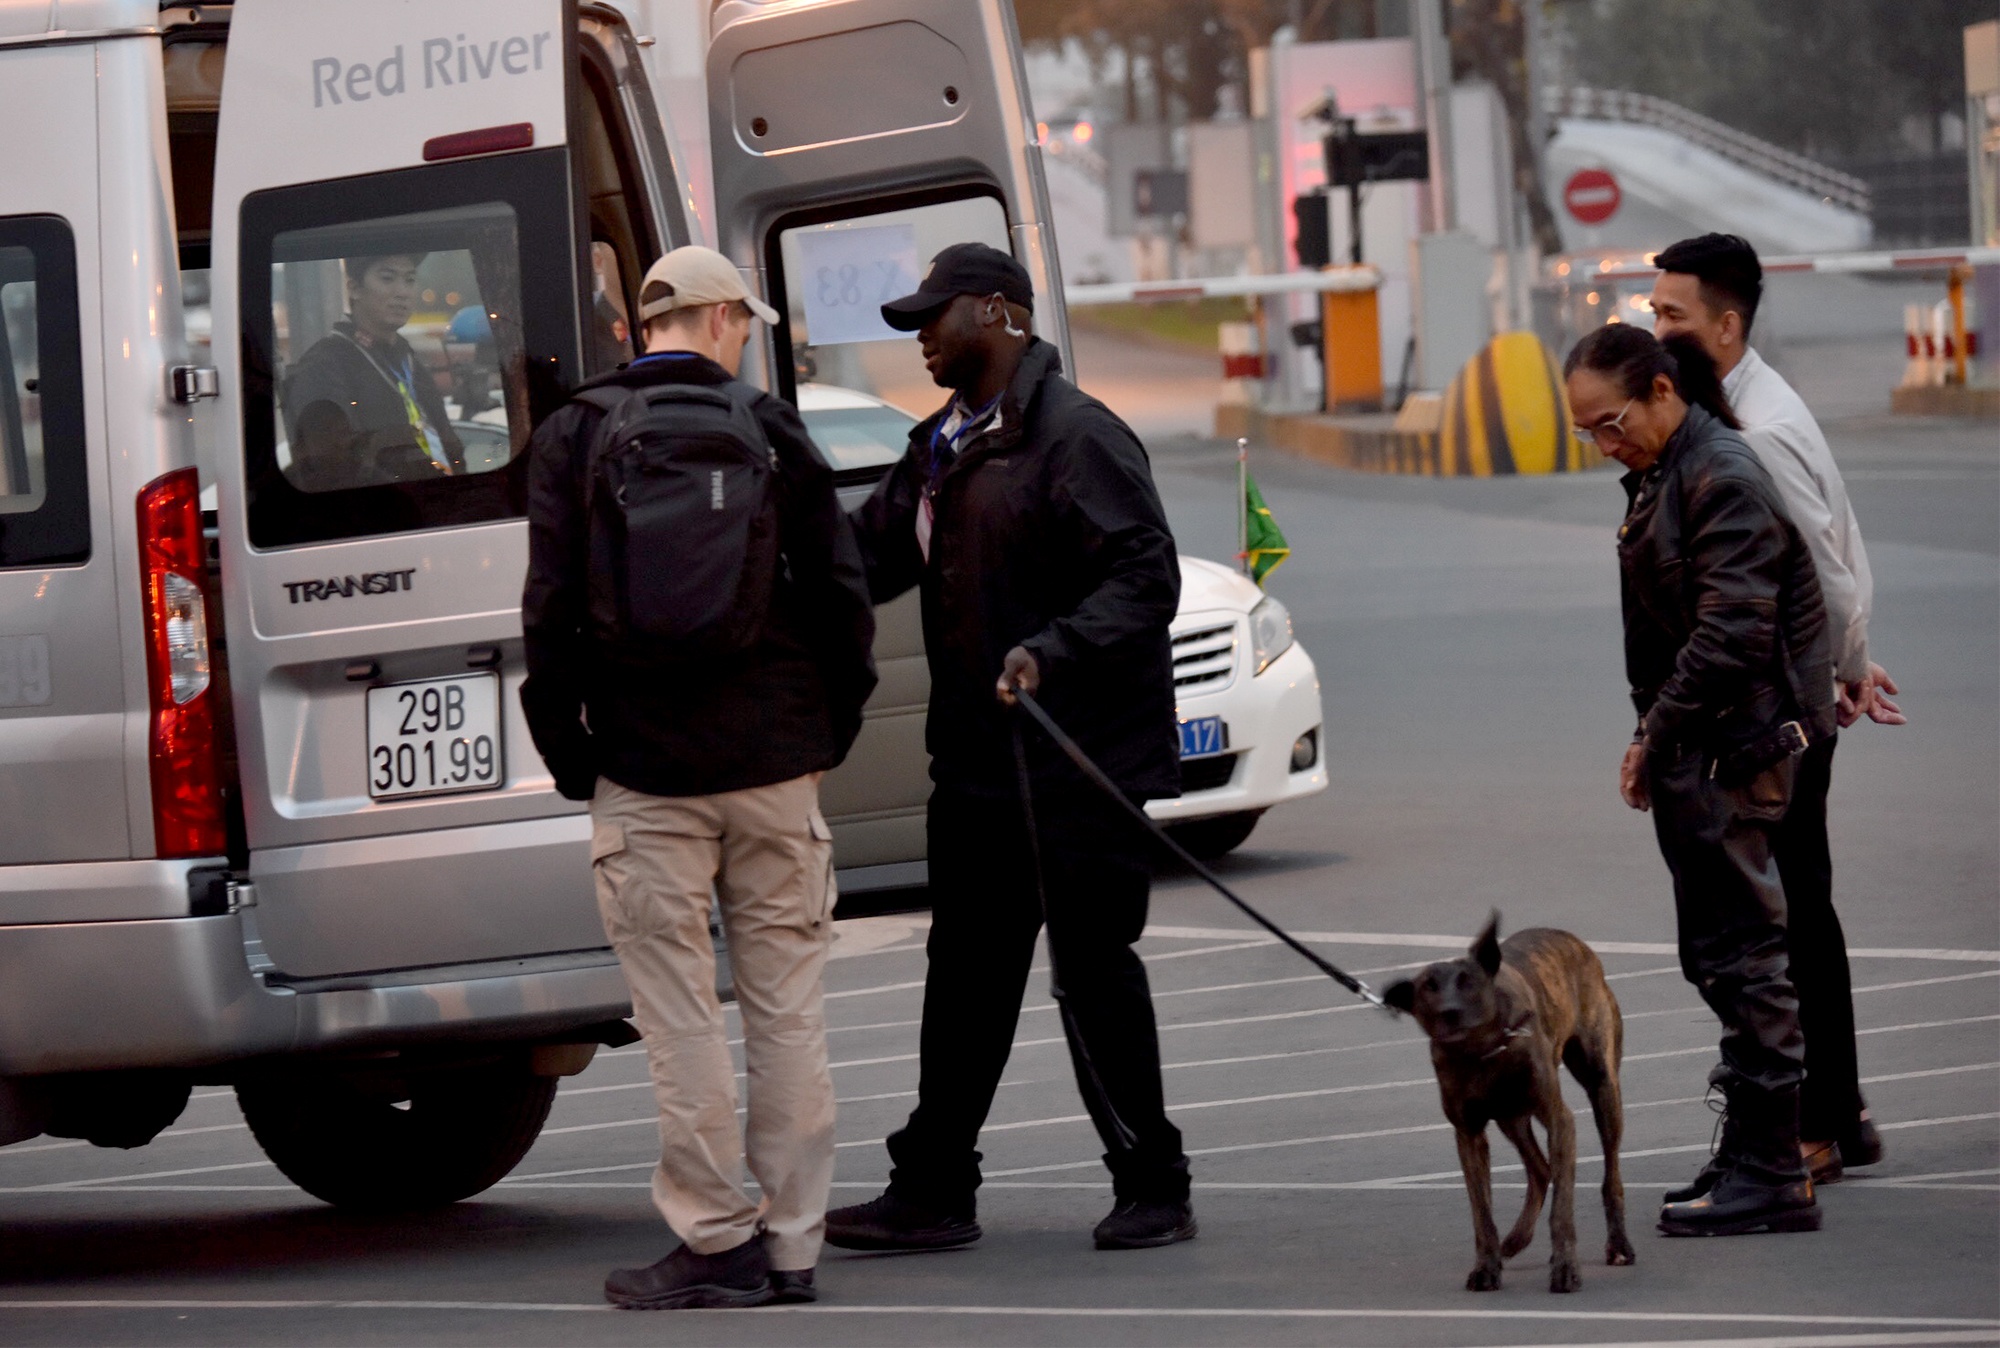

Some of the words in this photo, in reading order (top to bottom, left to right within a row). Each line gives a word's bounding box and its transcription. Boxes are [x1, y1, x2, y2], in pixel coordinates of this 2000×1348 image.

[312, 45, 406, 109] Red
[422, 30, 551, 90] River
[282, 567, 417, 605] TRANSIT
[398, 684, 465, 737] 29B
[373, 734, 494, 791] 301.99
